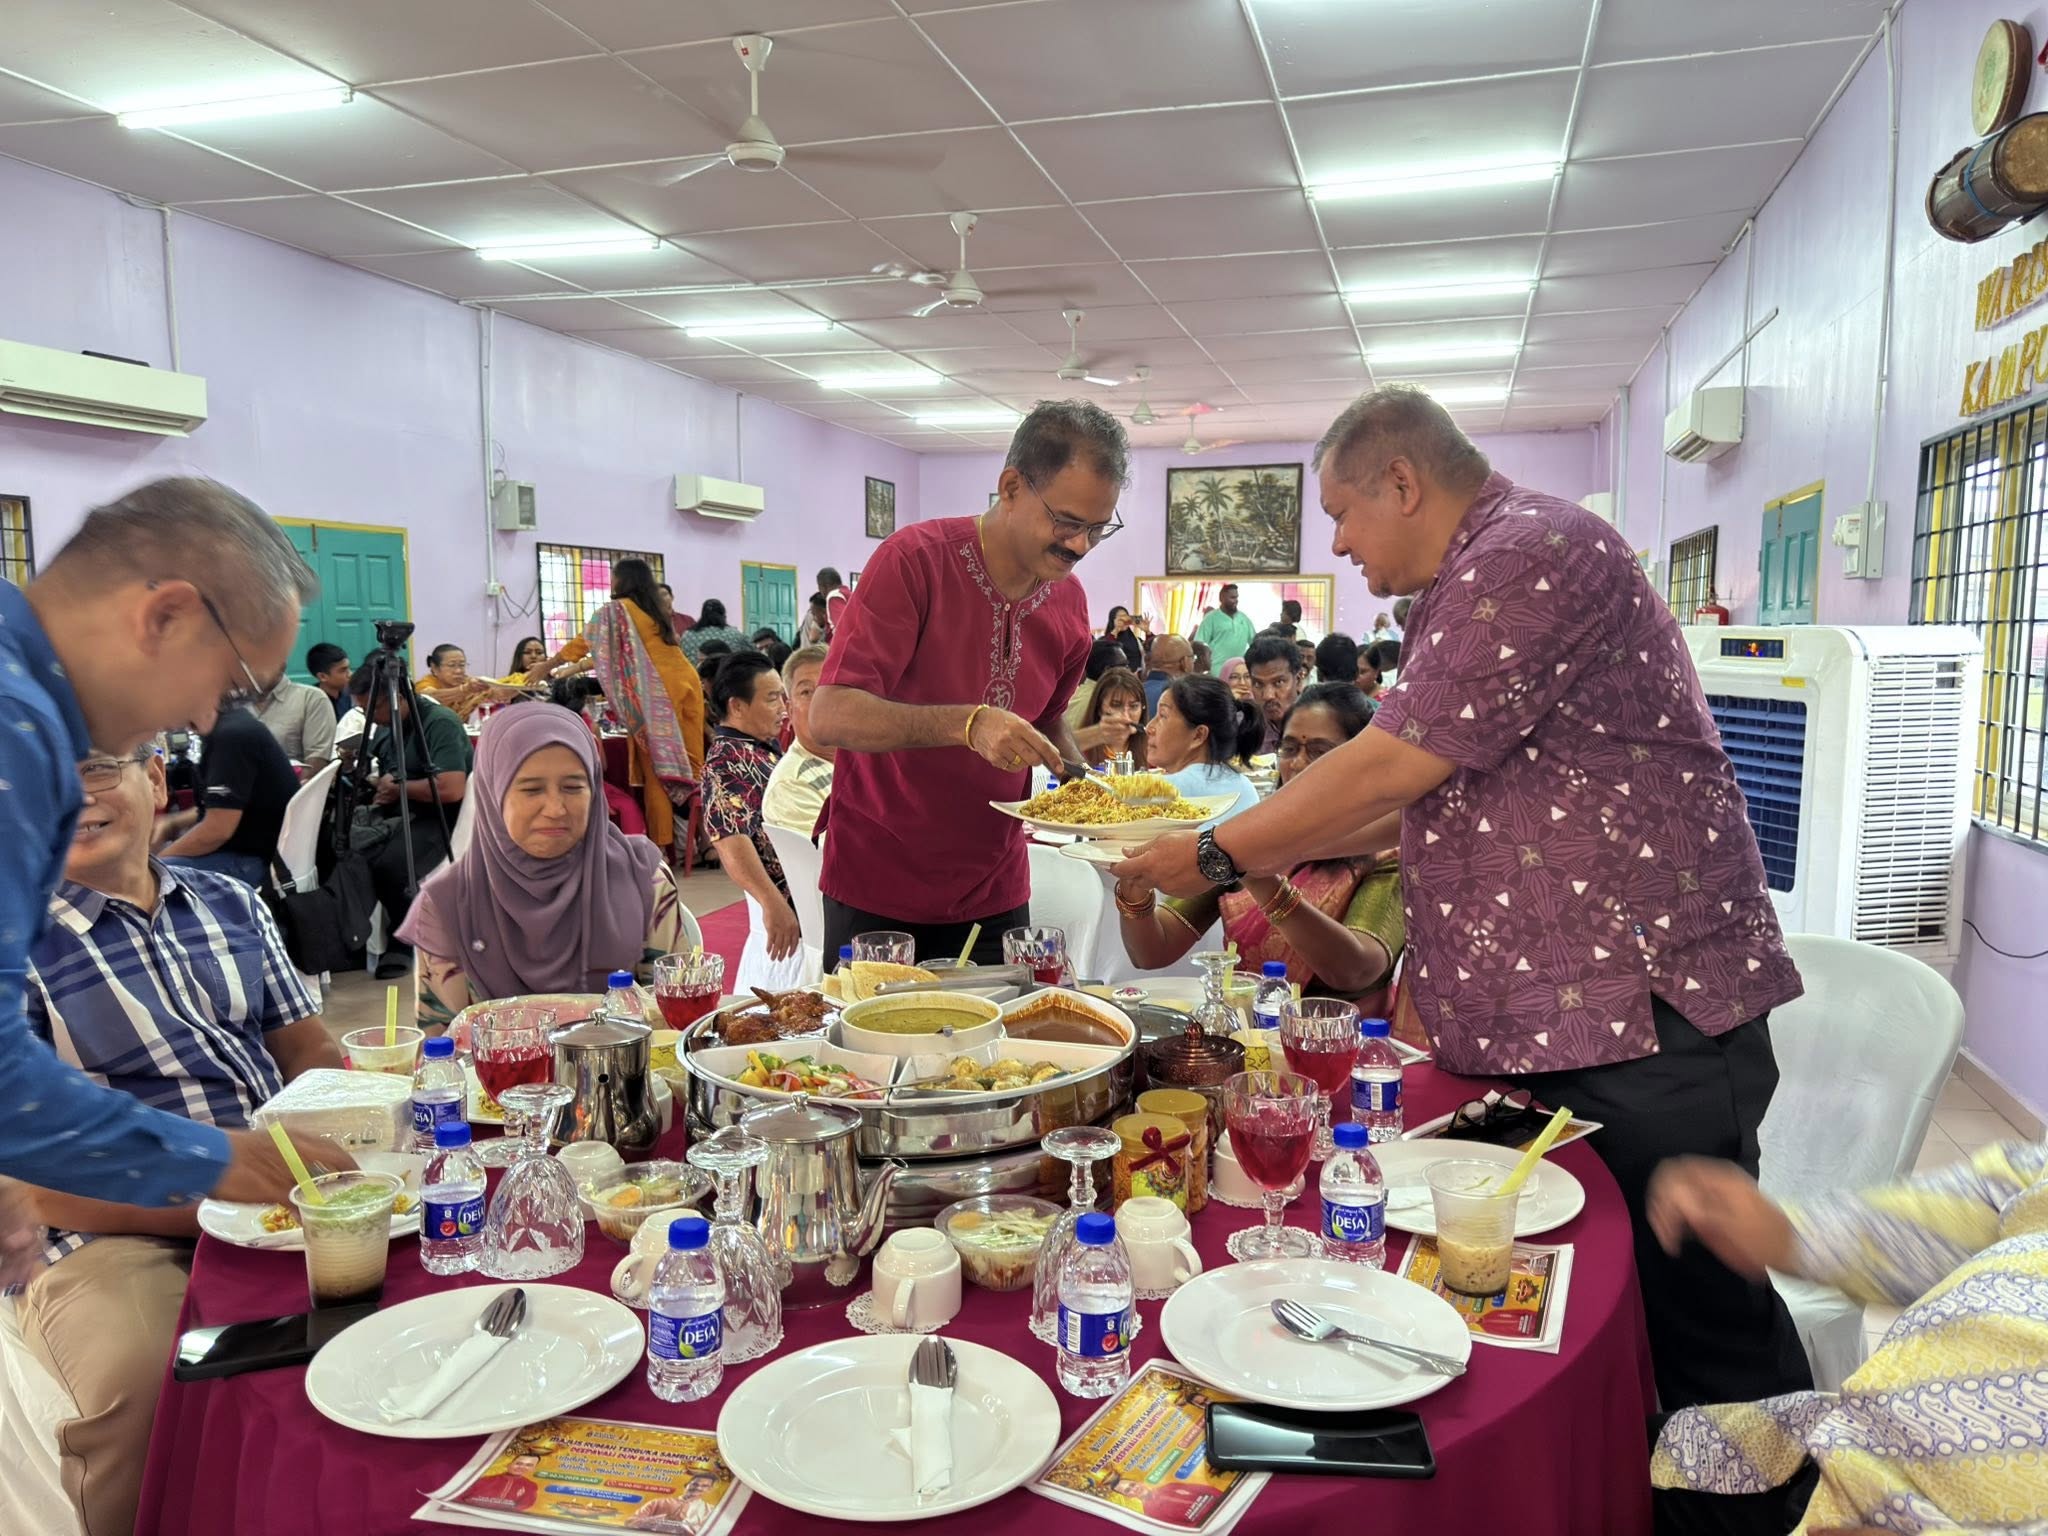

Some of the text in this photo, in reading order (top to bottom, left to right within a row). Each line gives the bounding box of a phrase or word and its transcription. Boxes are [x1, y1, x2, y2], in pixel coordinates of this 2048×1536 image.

[1335, 1214, 1365, 1230] DESA
[685, 1325, 716, 1344] DESA
[550, 1436, 583, 1447] MAJLIS
[583, 1441, 617, 1450] RUMAH
[618, 1444, 658, 1456] TERBUKA
[660, 1450, 710, 1462] SAMBUTAN
[570, 1447, 616, 1458] DEEPAVALI
[638, 1456, 681, 1465] BANTING
